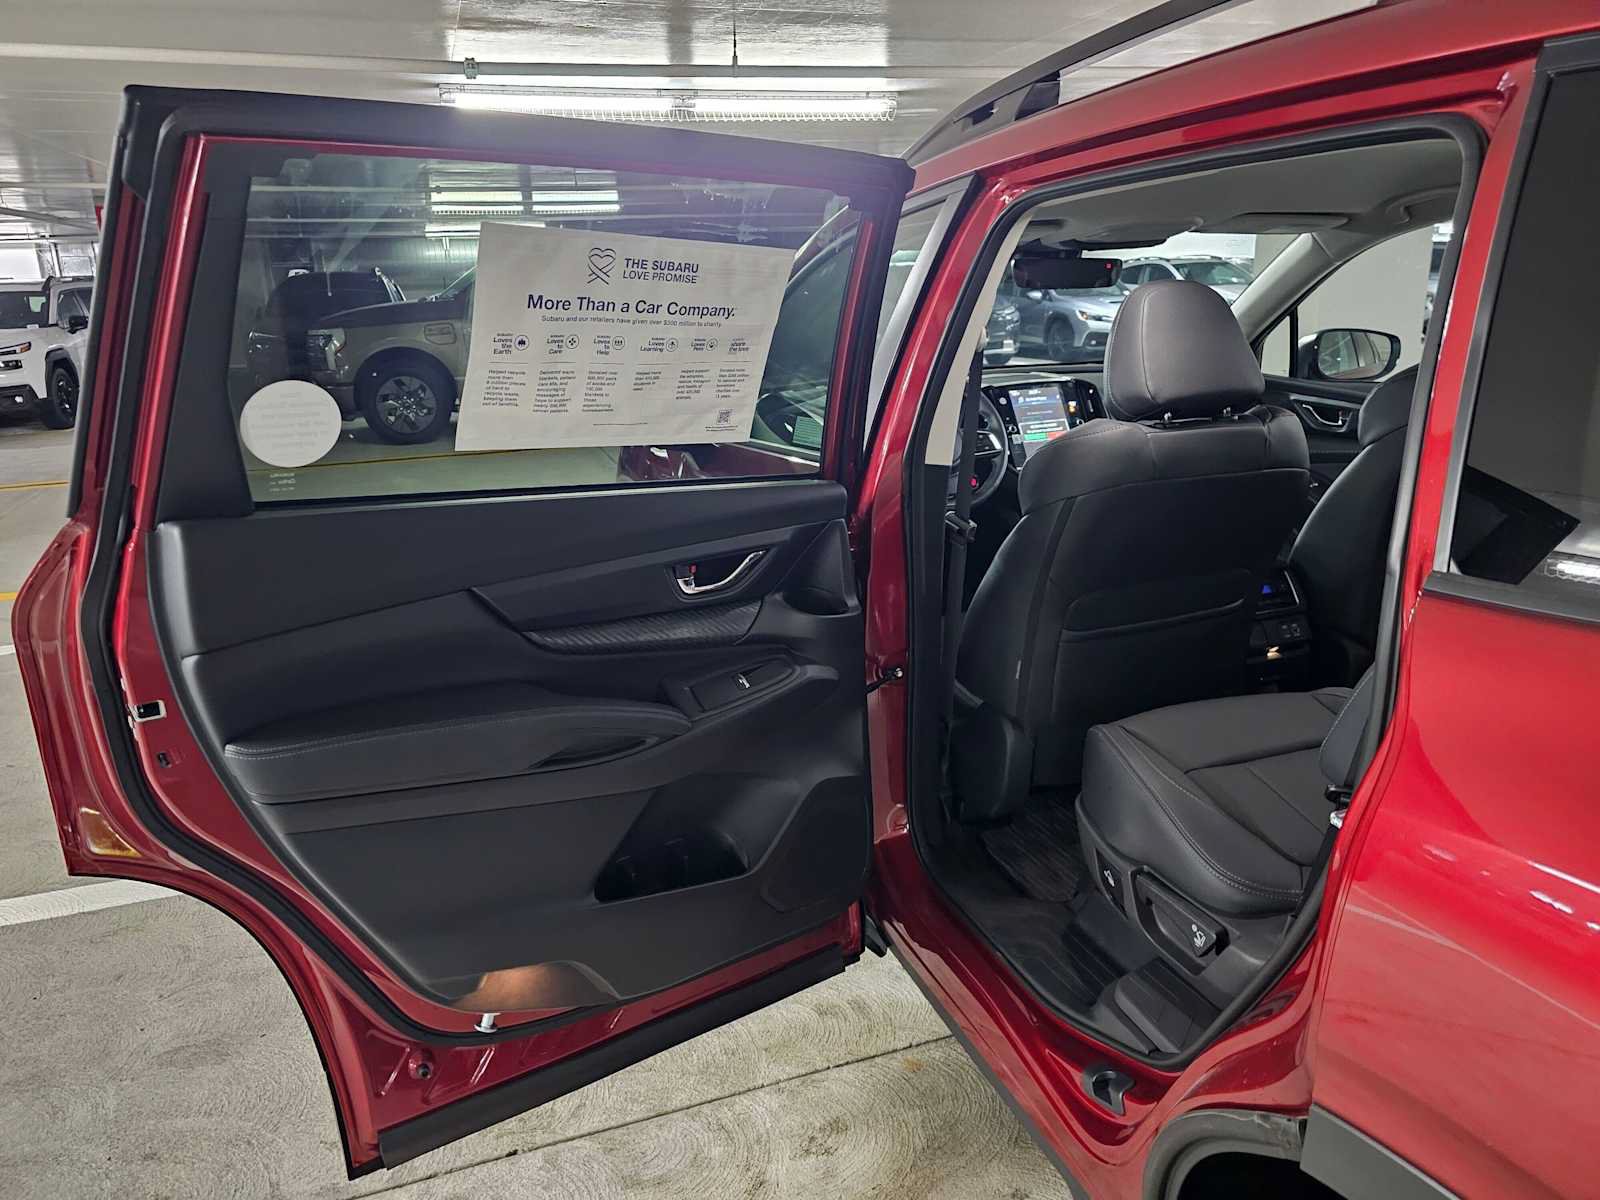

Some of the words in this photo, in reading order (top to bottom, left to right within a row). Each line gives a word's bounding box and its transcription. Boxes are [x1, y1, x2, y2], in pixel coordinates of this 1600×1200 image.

[624, 258, 648, 270] THE
[652, 260, 699, 273] SUBARU
[623, 270, 650, 281] LOVE
[652, 272, 698, 284] PROMISE
[527, 294, 572, 311] More
[577, 297, 616, 313] Than
[620, 302, 630, 313] a
[635, 300, 662, 314] Car
[667, 302, 736, 319] Company.
[640, 345, 664, 353] Learning
